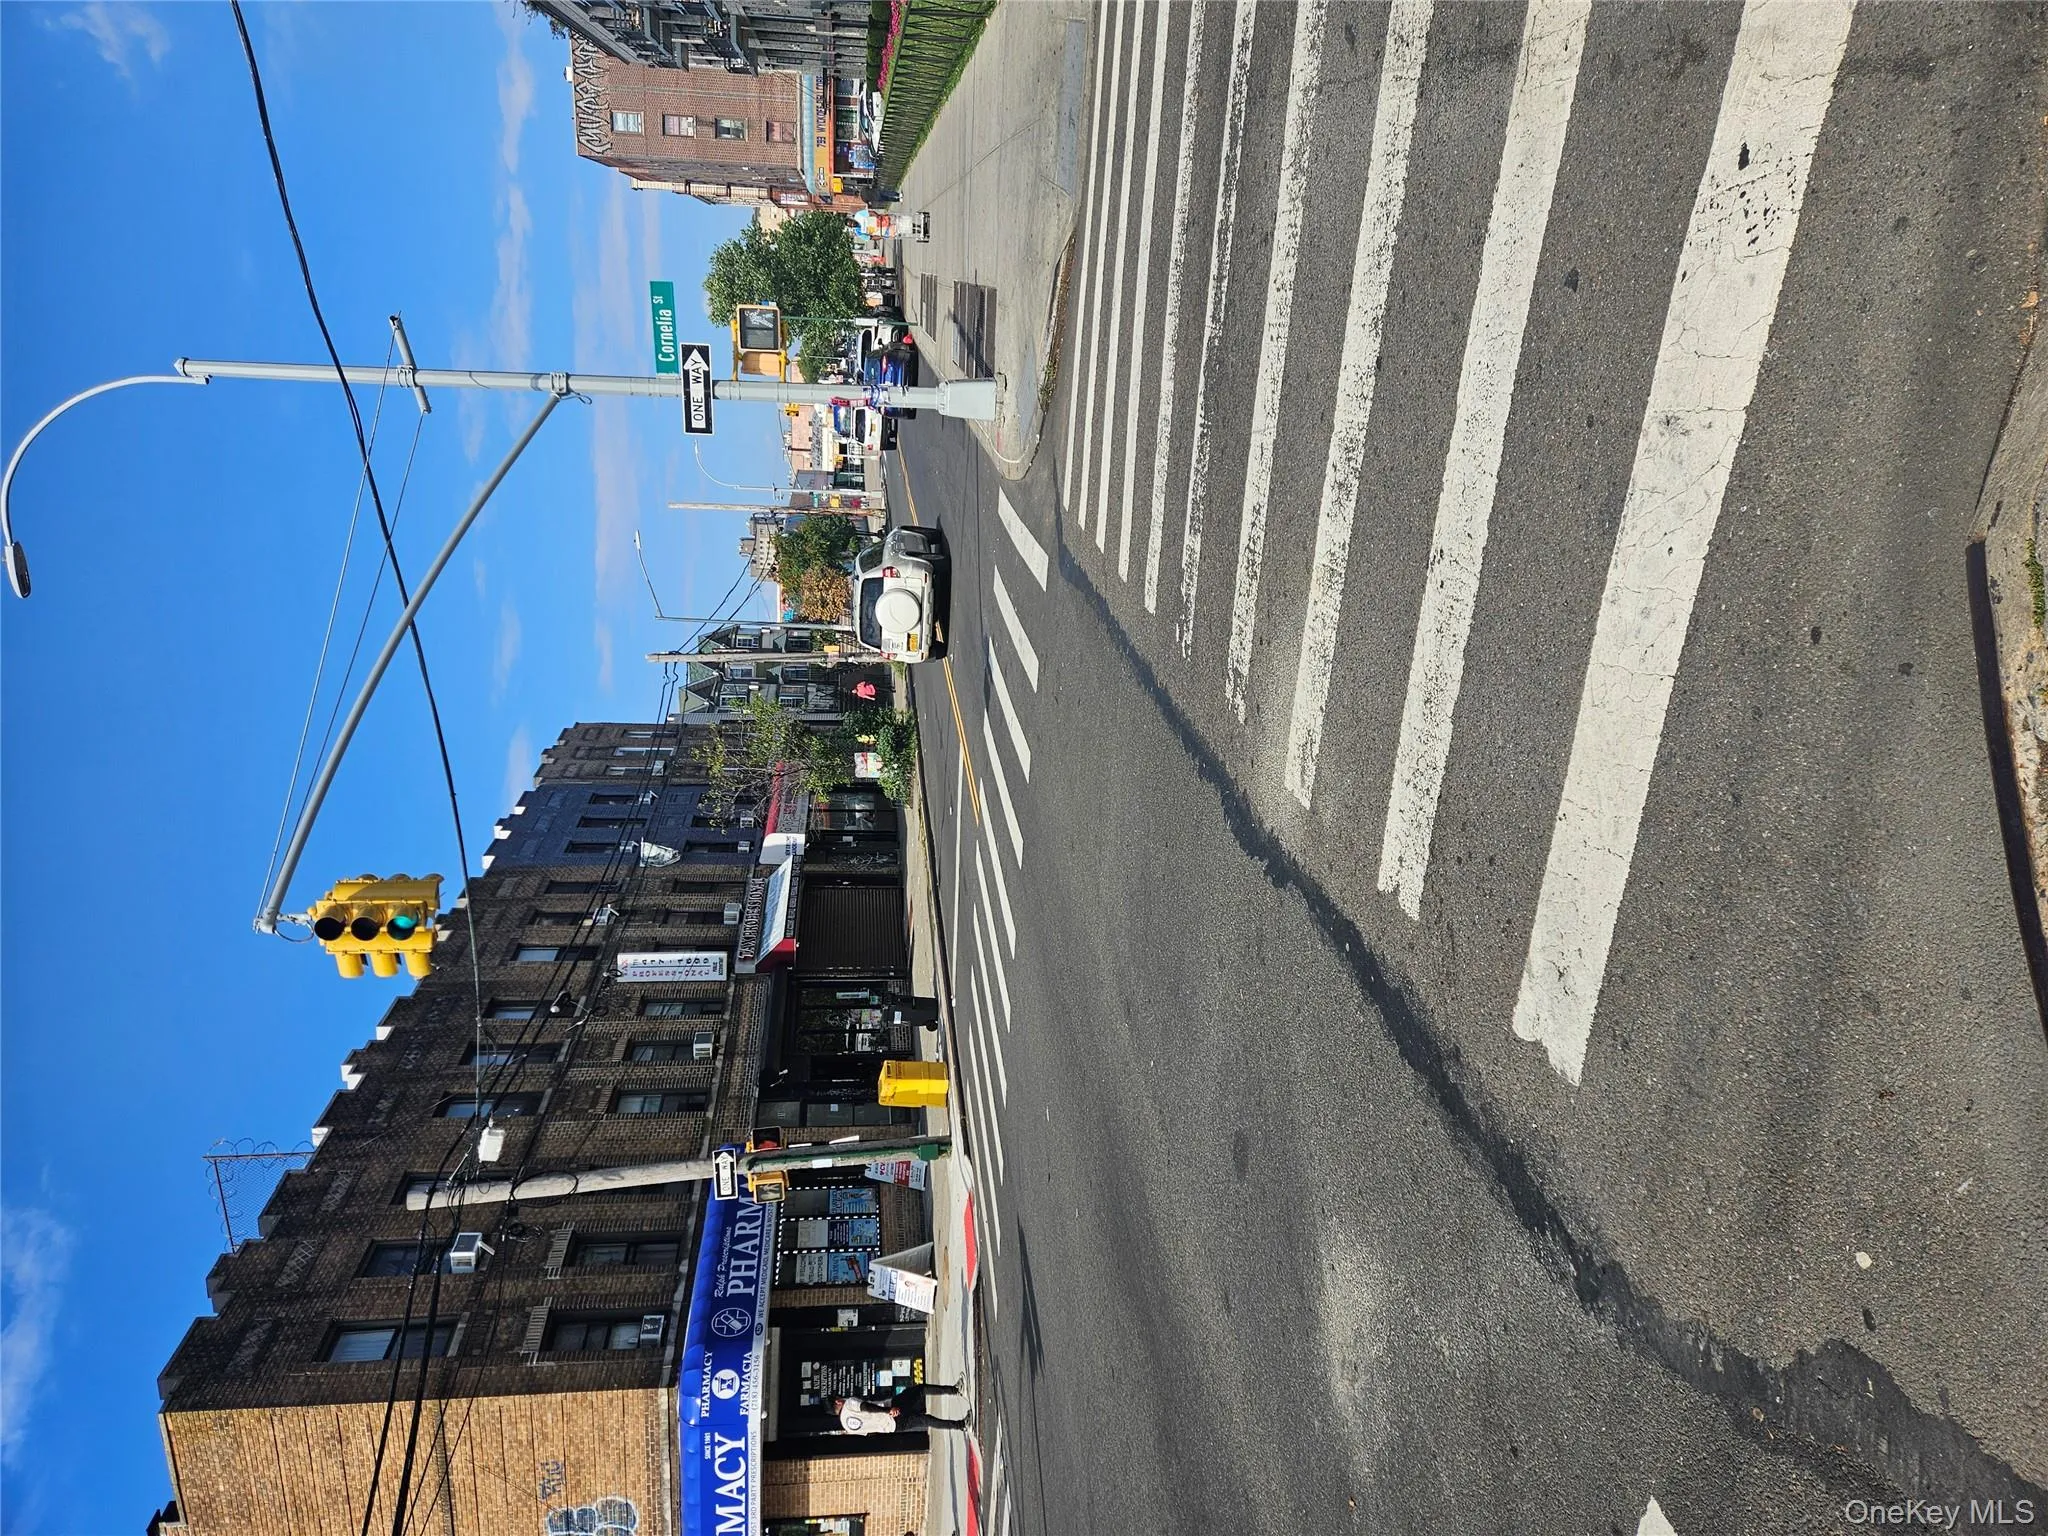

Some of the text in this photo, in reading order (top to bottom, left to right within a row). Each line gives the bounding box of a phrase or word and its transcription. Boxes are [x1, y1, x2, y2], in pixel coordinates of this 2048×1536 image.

[652, 295, 675, 362] Cornelia St
[690, 358, 704, 422] ONE WAY
[737, 877, 766, 959] TAX PROFESSIONAL
[720, 1156, 730, 1191] ONE WAY
[714, 1226, 732, 1298] Ralph Prescriptions
[726, 1182, 763, 1297] PHARM
[763, 1227, 772, 1255] MEDICARE
[758, 1308, 765, 1318] WE
[759, 1286, 767, 1308] ACCEPT
[701, 1350, 713, 1418] PHARMACY
[740, 1351, 752, 1416] FARMACIA
